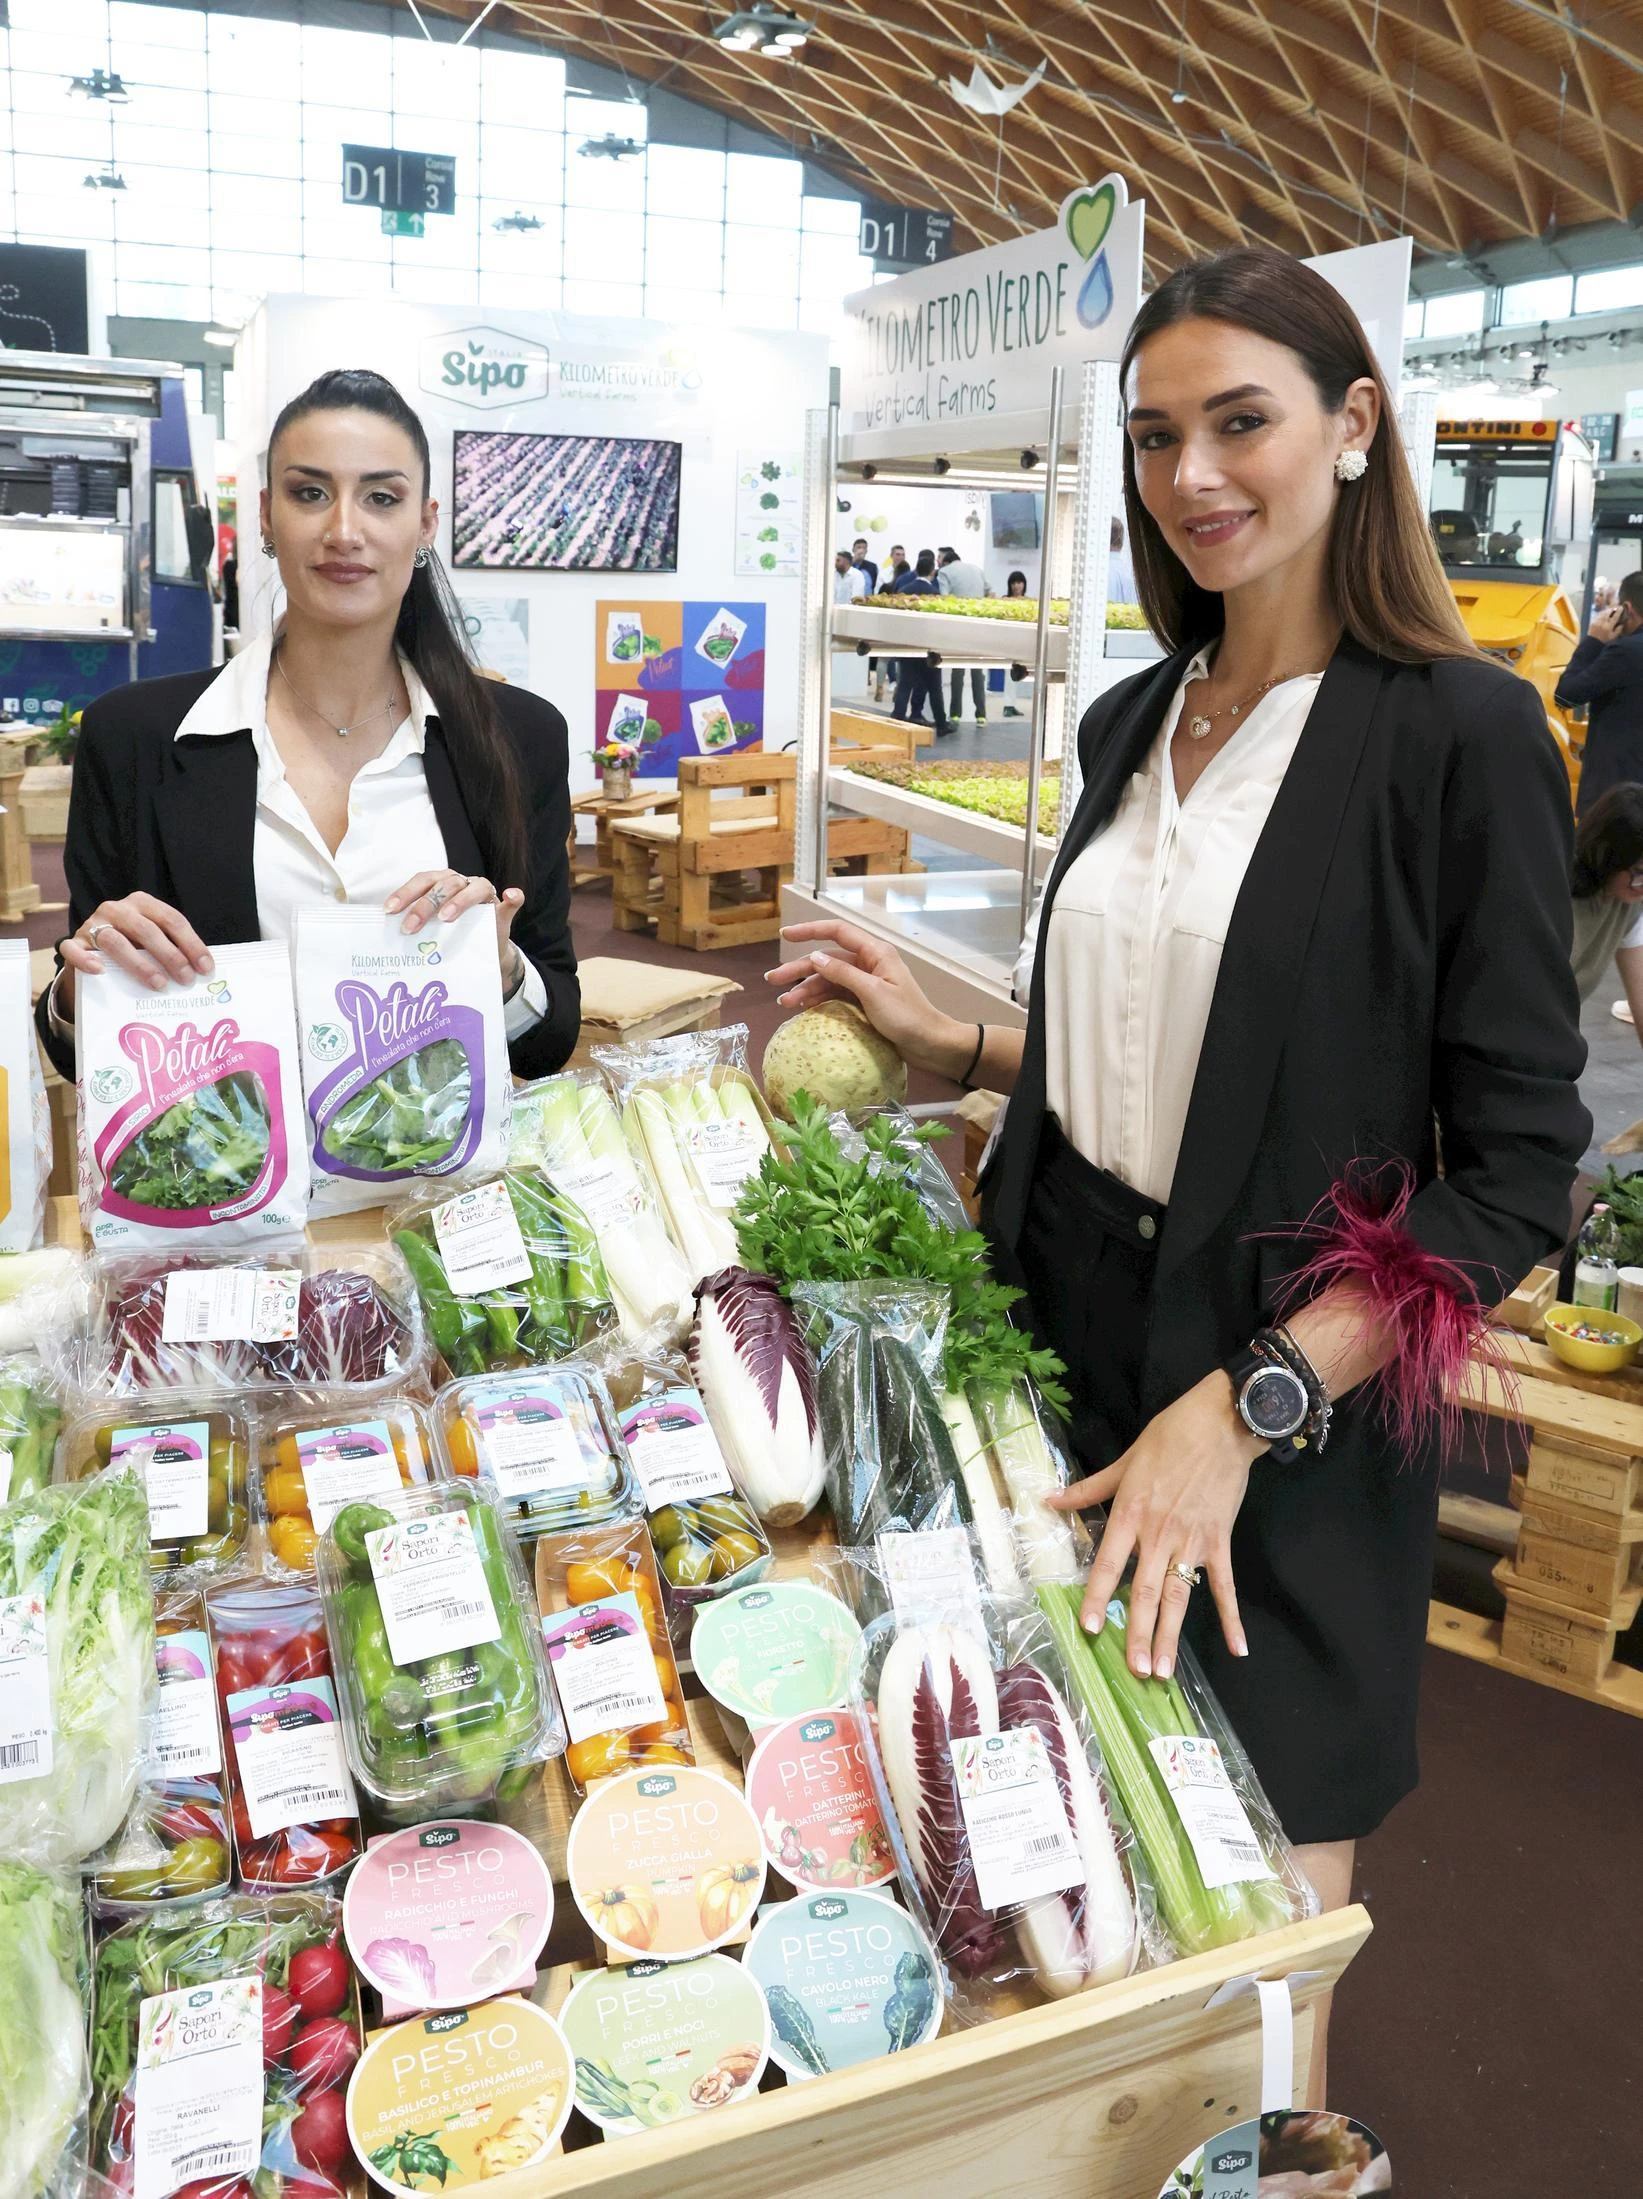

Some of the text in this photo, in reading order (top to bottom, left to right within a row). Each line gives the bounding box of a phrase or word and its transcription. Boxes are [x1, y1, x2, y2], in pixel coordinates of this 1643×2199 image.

[344, 161, 386, 204] D1
[426, 184, 439, 210] 3
[860, 218, 897, 256] D1
[925, 240, 937, 262] 4
[986, 263, 1069, 354] VERDE
[441, 350, 528, 396] Sipo
[559, 361, 639, 385] KILOMETRO
[351, 954, 426, 968] KILOMETRO VERDE
[135, 996, 215, 1011] KILOMETRO VERDE
[341, 986, 444, 1070] Petali
[405, 1036, 420, 1049] che
[419, 1027, 435, 1041] non
[125, 1022, 235, 1107] Petali
[196, 1070, 211, 1085] che
[210, 1063, 226, 1078] non
[320, 1069, 364, 1115] ANDROMEDA
[128, 1107, 150, 1127] SIRIO
[212, 1183, 269, 1219] INCONTAMINATA
[95, 1222, 114, 1232] APRI
[95, 1225, 129, 1238] E GUSTA
[402, 1535, 440, 1551] Sapori
[408, 1548, 438, 1560] Orto
[599, 1626, 619, 1637] PIACERE
[720, 1604, 815, 1645] PESTO
[290, 1713, 313, 1722] PIACERE
[805, 1726, 831, 1740] Sipo
[981, 1756, 1017, 1770] Sapori
[987, 1767, 1017, 1782] Orto
[643, 1782, 672, 1795] Sipo
[786, 1771, 865, 1802] FRESC
[812, 1791, 866, 1812] DATTERINI
[607, 1800, 719, 1840] PESTO
[794, 1807, 843, 1828] DATTERINO
[425, 1832, 454, 1846] Sipo
[612, 1829, 721, 1852] FRESCO
[387, 1847, 504, 1888] PESTO
[627, 1848, 713, 1870] ZUCCA GIALLA
[391, 1874, 505, 1902] FRESCO
[384, 1888, 519, 1921] RADICCHIO E FUNGHI
[815, 1903, 844, 1918] Sipo
[369, 1917, 434, 1936] RADICCHIO
[460, 1899, 535, 1921] MUSHROOMS
[780, 1924, 892, 1965] PESTO
[632, 1964, 661, 1975] Sipo
[786, 1954, 896, 1982] FRESCO
[801, 1974, 889, 1997] CAVOLO NERO
[596, 1972, 714, 2025] PESTO
[815, 1990, 880, 2008] BLACK KALE
[178, 2008, 223, 2033] Sapori
[430, 2015, 463, 2032] Sipo
[602, 1998, 718, 2041] FRESCO
[182, 2026, 217, 2045] Orto
[622, 2019, 705, 2052] PORRI E NOCI
[668, 2030, 721, 2052] WALNUTS
[391, 2023, 518, 2084] PESTO
[397, 2050, 521, 2099] FRESCO
[377, 2094, 440, 2123] BASILICO
[442, 2090, 451, 2101] E
[453, 2060, 545, 2097] TOPINAMBUR
[176, 2104, 220, 2120] RAVANELLI
[361, 2123, 397, 2142] BASIL
[397, 2113, 424, 2130] AND
[423, 2091, 493, 2122] JERUSALEM
[494, 2067, 566, 2098] ARTICHOKES
[1218, 2156, 1247, 2172] Sipo
